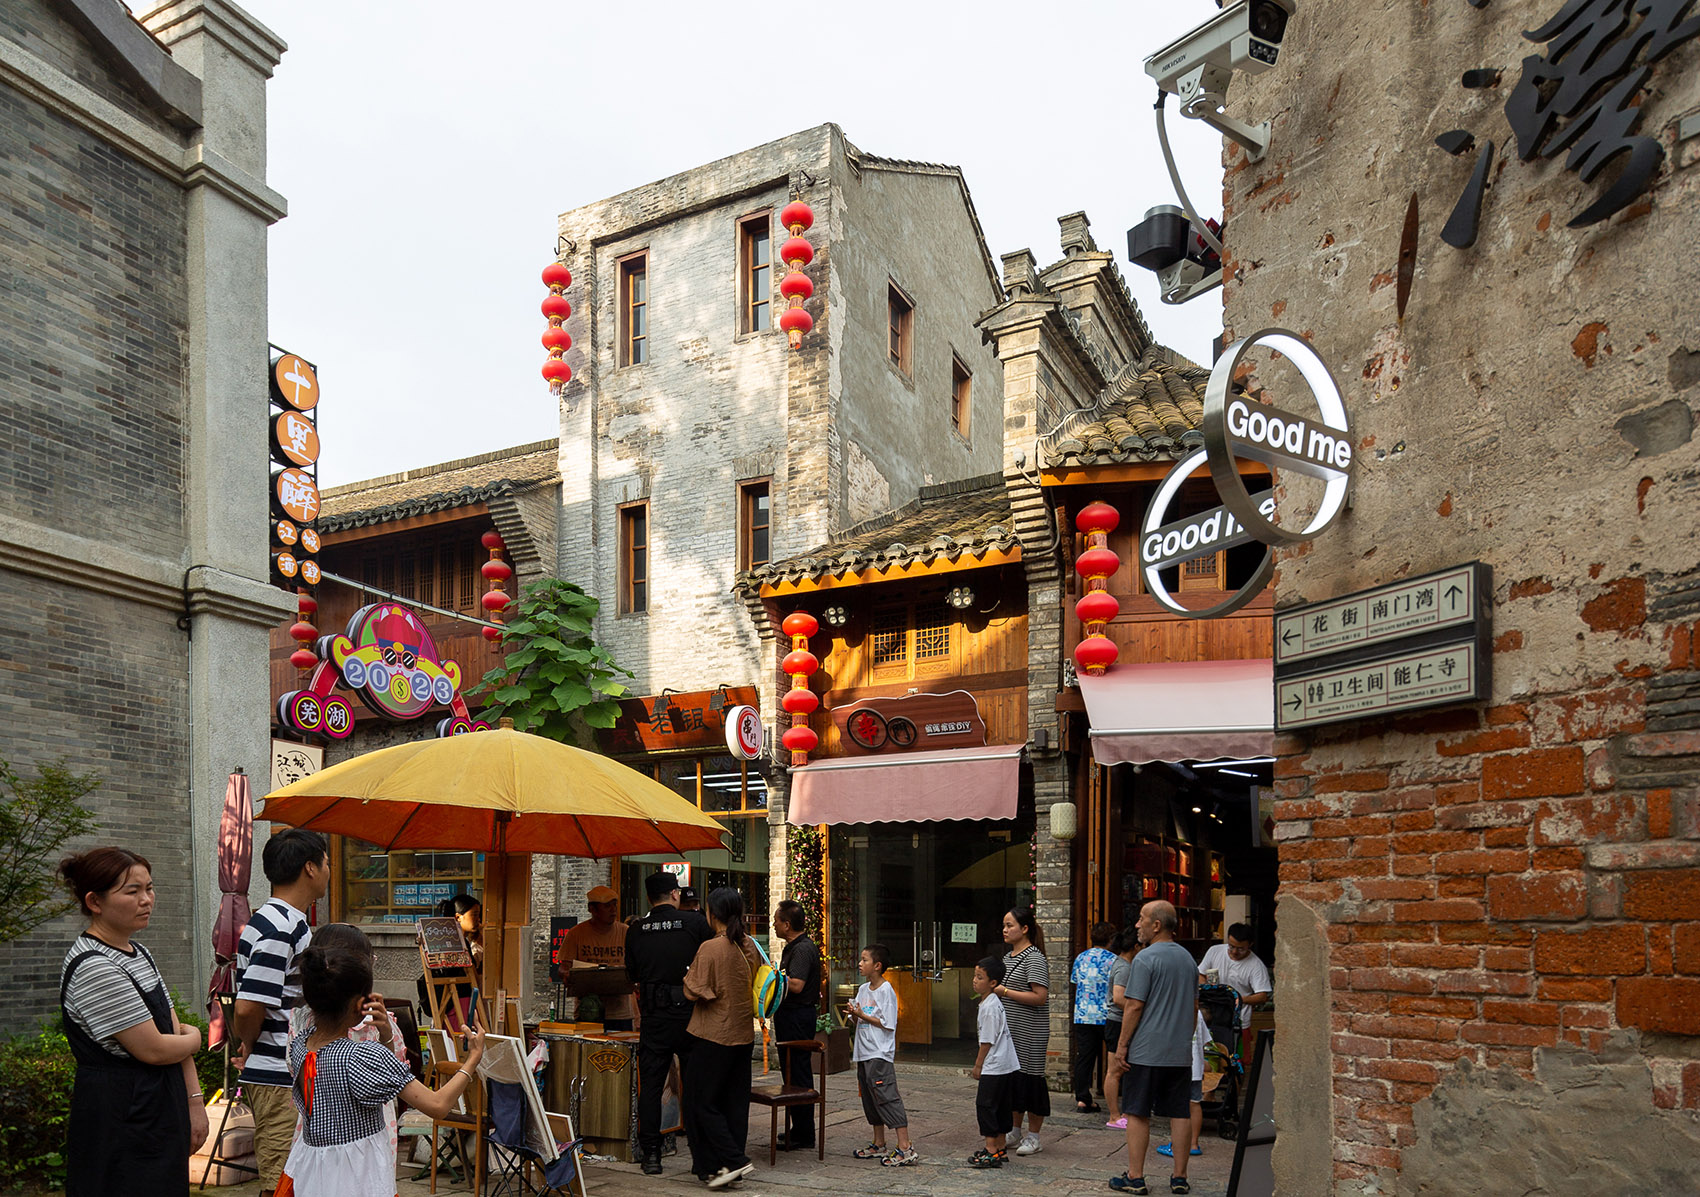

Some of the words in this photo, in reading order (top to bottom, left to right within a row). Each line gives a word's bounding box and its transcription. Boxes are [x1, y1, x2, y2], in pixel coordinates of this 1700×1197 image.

[1227, 400, 1305, 455] Good
[1307, 429, 1351, 469] me
[1142, 510, 1223, 563] Good
[1372, 588, 1434, 620] 南门湾
[1312, 607, 1358, 634] 花街
[1328, 672, 1384, 699] 卫生间
[1394, 657, 1456, 687] 能仁寺
[300, 702, 346, 728] 芜湖
[956, 720, 971, 731] DIY
